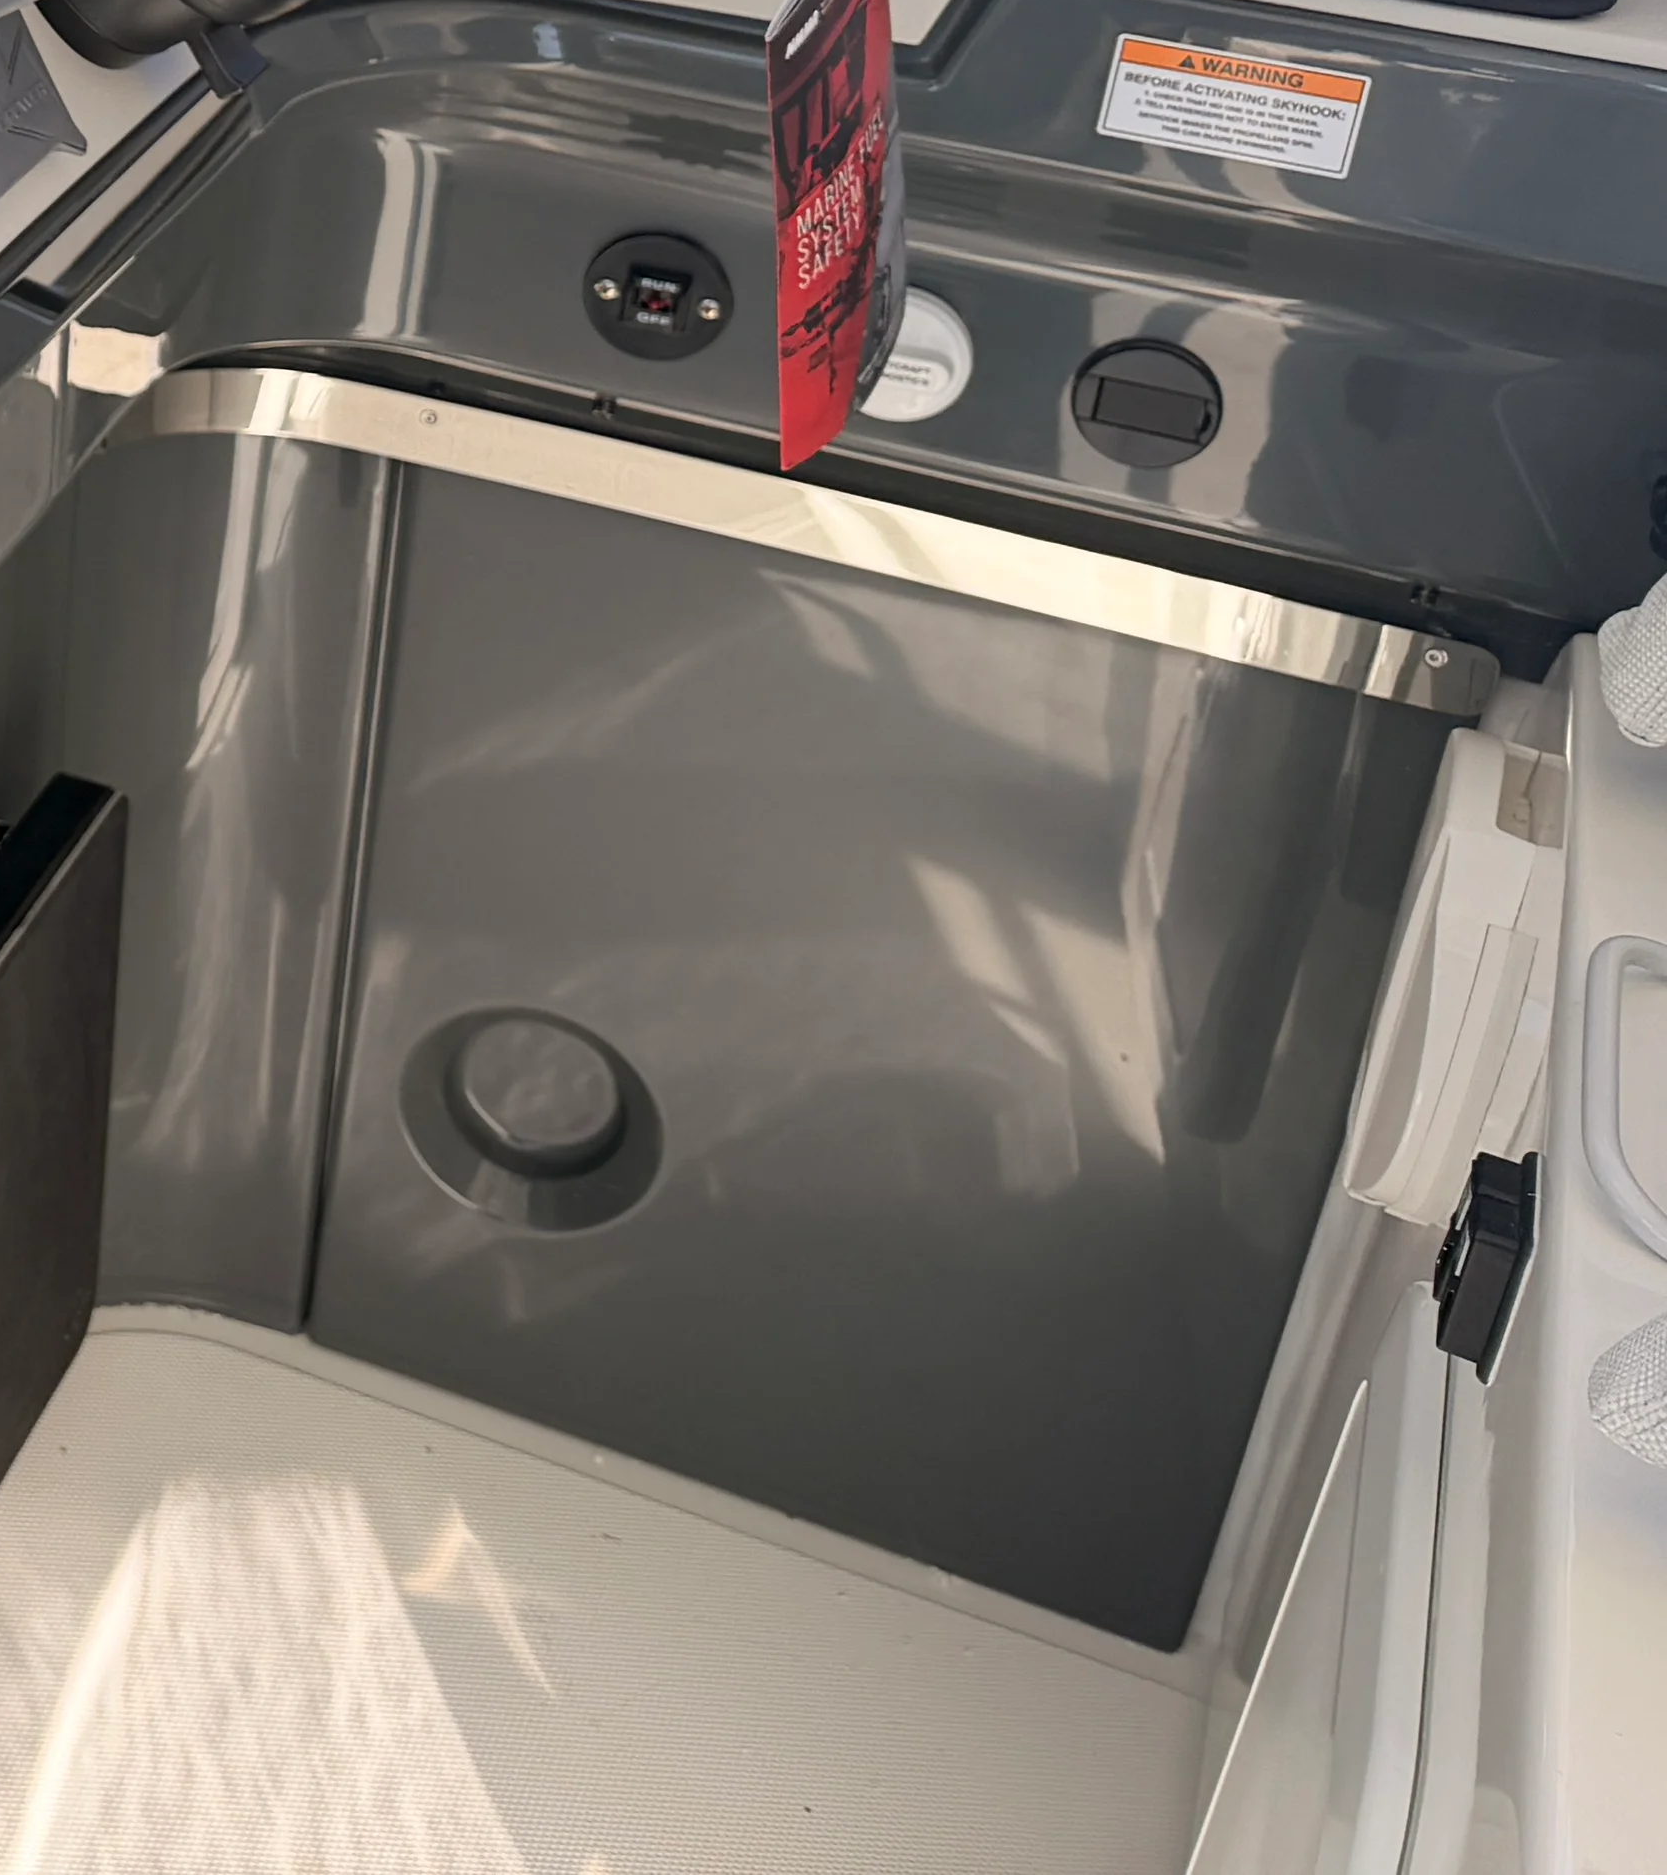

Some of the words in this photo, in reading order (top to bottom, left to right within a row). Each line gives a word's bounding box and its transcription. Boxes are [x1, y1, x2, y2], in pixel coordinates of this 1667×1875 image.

[1123, 71, 1181, 90] BEFORE
[1183, 81, 1268, 106] ACTIVATING
[1271, 97, 1346, 121] SKYHOOK:
[1200, 57, 1305, 88] WARNING
[797, 163, 856, 239] MARINE
[858, 107, 885, 164] FUEL
[797, 185, 863, 263] SYSTEM
[798, 211, 863, 290] SAFETY
[641, 277, 679, 293] RUN
[636, 312, 671, 326] OFF
